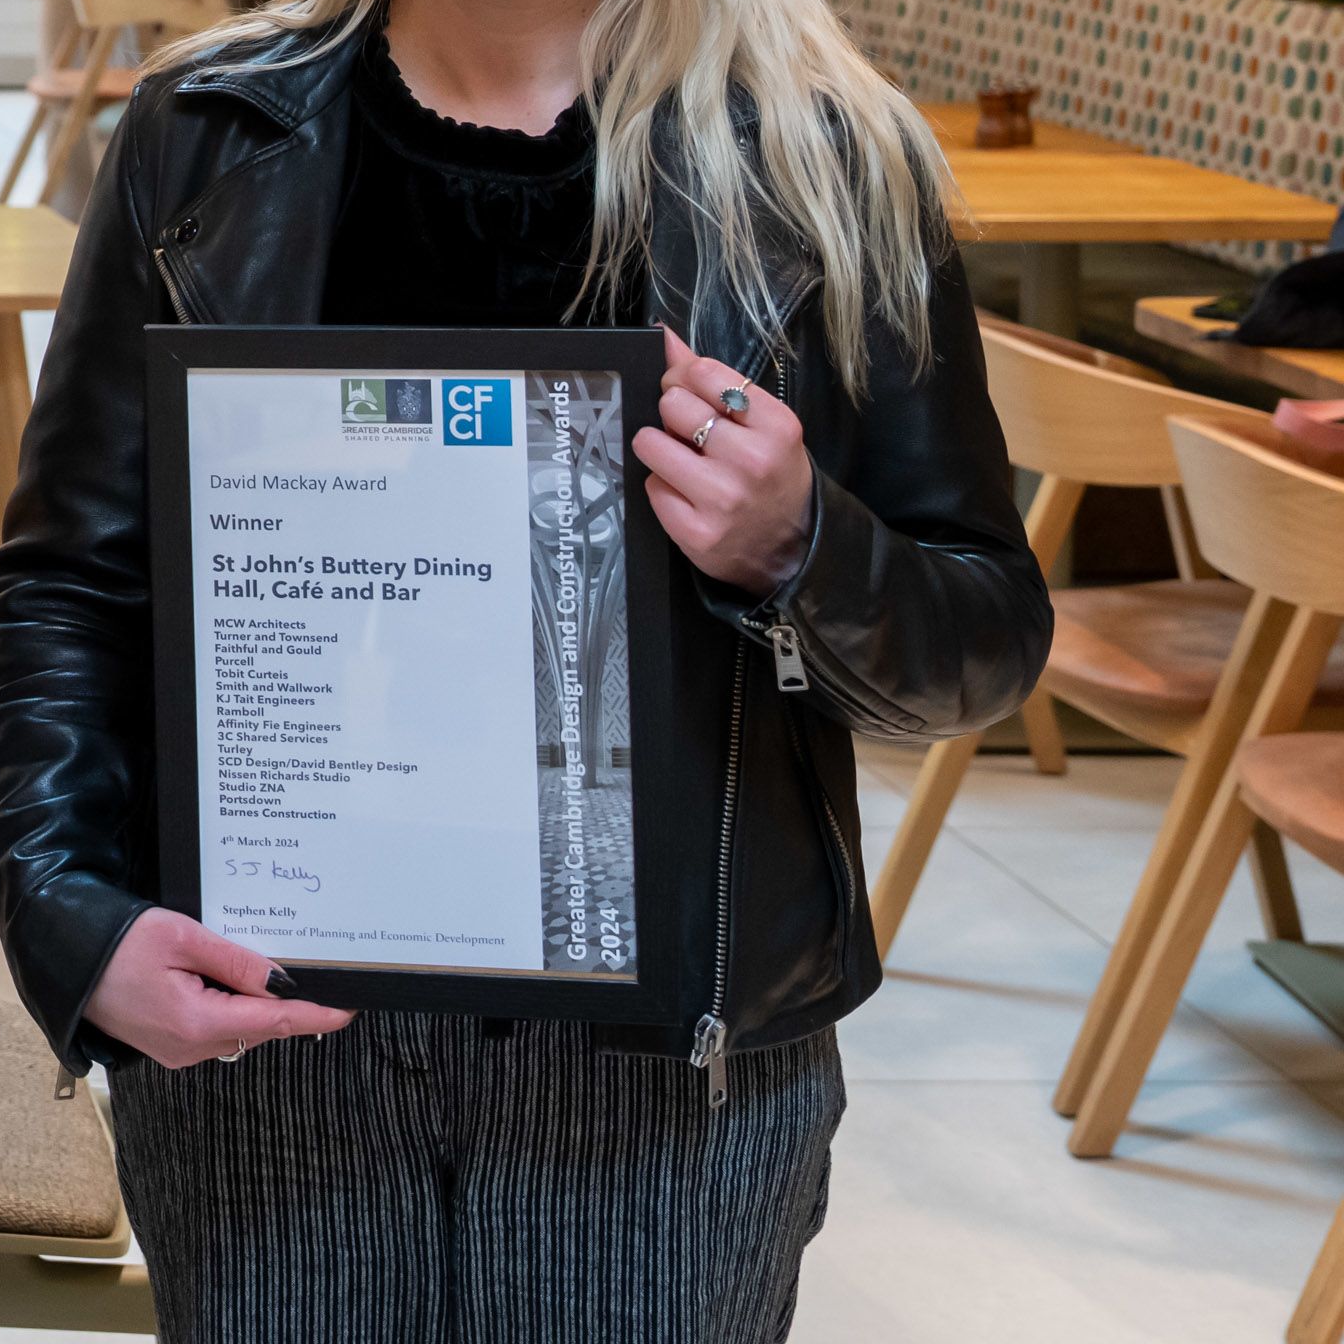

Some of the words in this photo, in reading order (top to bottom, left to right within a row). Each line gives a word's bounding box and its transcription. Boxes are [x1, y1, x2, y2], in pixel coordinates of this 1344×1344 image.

[448, 385, 493, 412] CF
[550, 380, 571, 465] Awards
[210, 474, 257, 490] David
[262, 474, 328, 494] Mackay
[331, 475, 387, 491] Award
[209, 513, 284, 531] Winner
[555, 472, 576, 614] Construction
[212, 553, 235, 573] St
[321, 556, 407, 581] Buttery
[413, 557, 492, 582] Dining
[213, 578, 265, 601] Hall,
[271, 579, 324, 600] Café
[330, 581, 374, 601] and
[381, 582, 421, 601] Bar
[213, 618, 246, 629] MCW
[247, 618, 307, 630] Architects
[213, 630, 252, 641] Turner
[254, 631, 277, 642] and
[278, 631, 338, 643] Townsend
[555, 620, 577, 662] and
[214, 643, 258, 654] Faithful
[261, 644, 284, 655] and
[286, 644, 322, 656] Gould
[214, 655, 255, 667] Purcell
[214, 668, 245, 679] Tobit
[247, 669, 289, 680] Curteis
[215, 680, 249, 692] Smith
[252, 681, 274, 692] and
[276, 682, 333, 694] Wallwork
[216, 693, 231, 704] KJ
[232, 694, 255, 705] Tait
[257, 694, 316, 708] Engineers
[560, 669, 583, 743] Design
[216, 705, 265, 717] Ramboll
[216, 718, 260, 732] Affinity
[262, 719, 281, 730] Fie
[283, 720, 342, 734] Engineers
[217, 731, 234, 742] 3C
[235, 731, 277, 743] Shared
[279, 732, 329, 744] Services
[216, 743, 254, 757] Turley
[218, 756, 243, 767] SCD
[328, 759, 374, 774] Bentley
[376, 761, 418, 775] Design
[218, 768, 257, 780] Nissen
[260, 770, 310, 782] Richards
[312, 771, 351, 783] Studio
[218, 781, 257, 793] Studio
[259, 782, 286, 793] ZNA
[219, 793, 282, 806] Portsdown
[219, 806, 260, 818] Barnes
[261, 807, 337, 820] Construction
[564, 750, 586, 870] Cambridge
[237, 836, 272, 847] March
[274, 838, 299, 848] 2024
[222, 904, 266, 918] Stephen
[269, 906, 297, 920] Kelly
[567, 875, 587, 961] Greater
[221, 923, 248, 936] Joint
[250, 924, 294, 937] Director
[295, 926, 308, 937] of
[309, 927, 356, 942] Planning
[358, 929, 378, 940] and
[380, 930, 432, 943] Economic
[435, 932, 505, 947] Development
[599, 907, 620, 962] 2024
